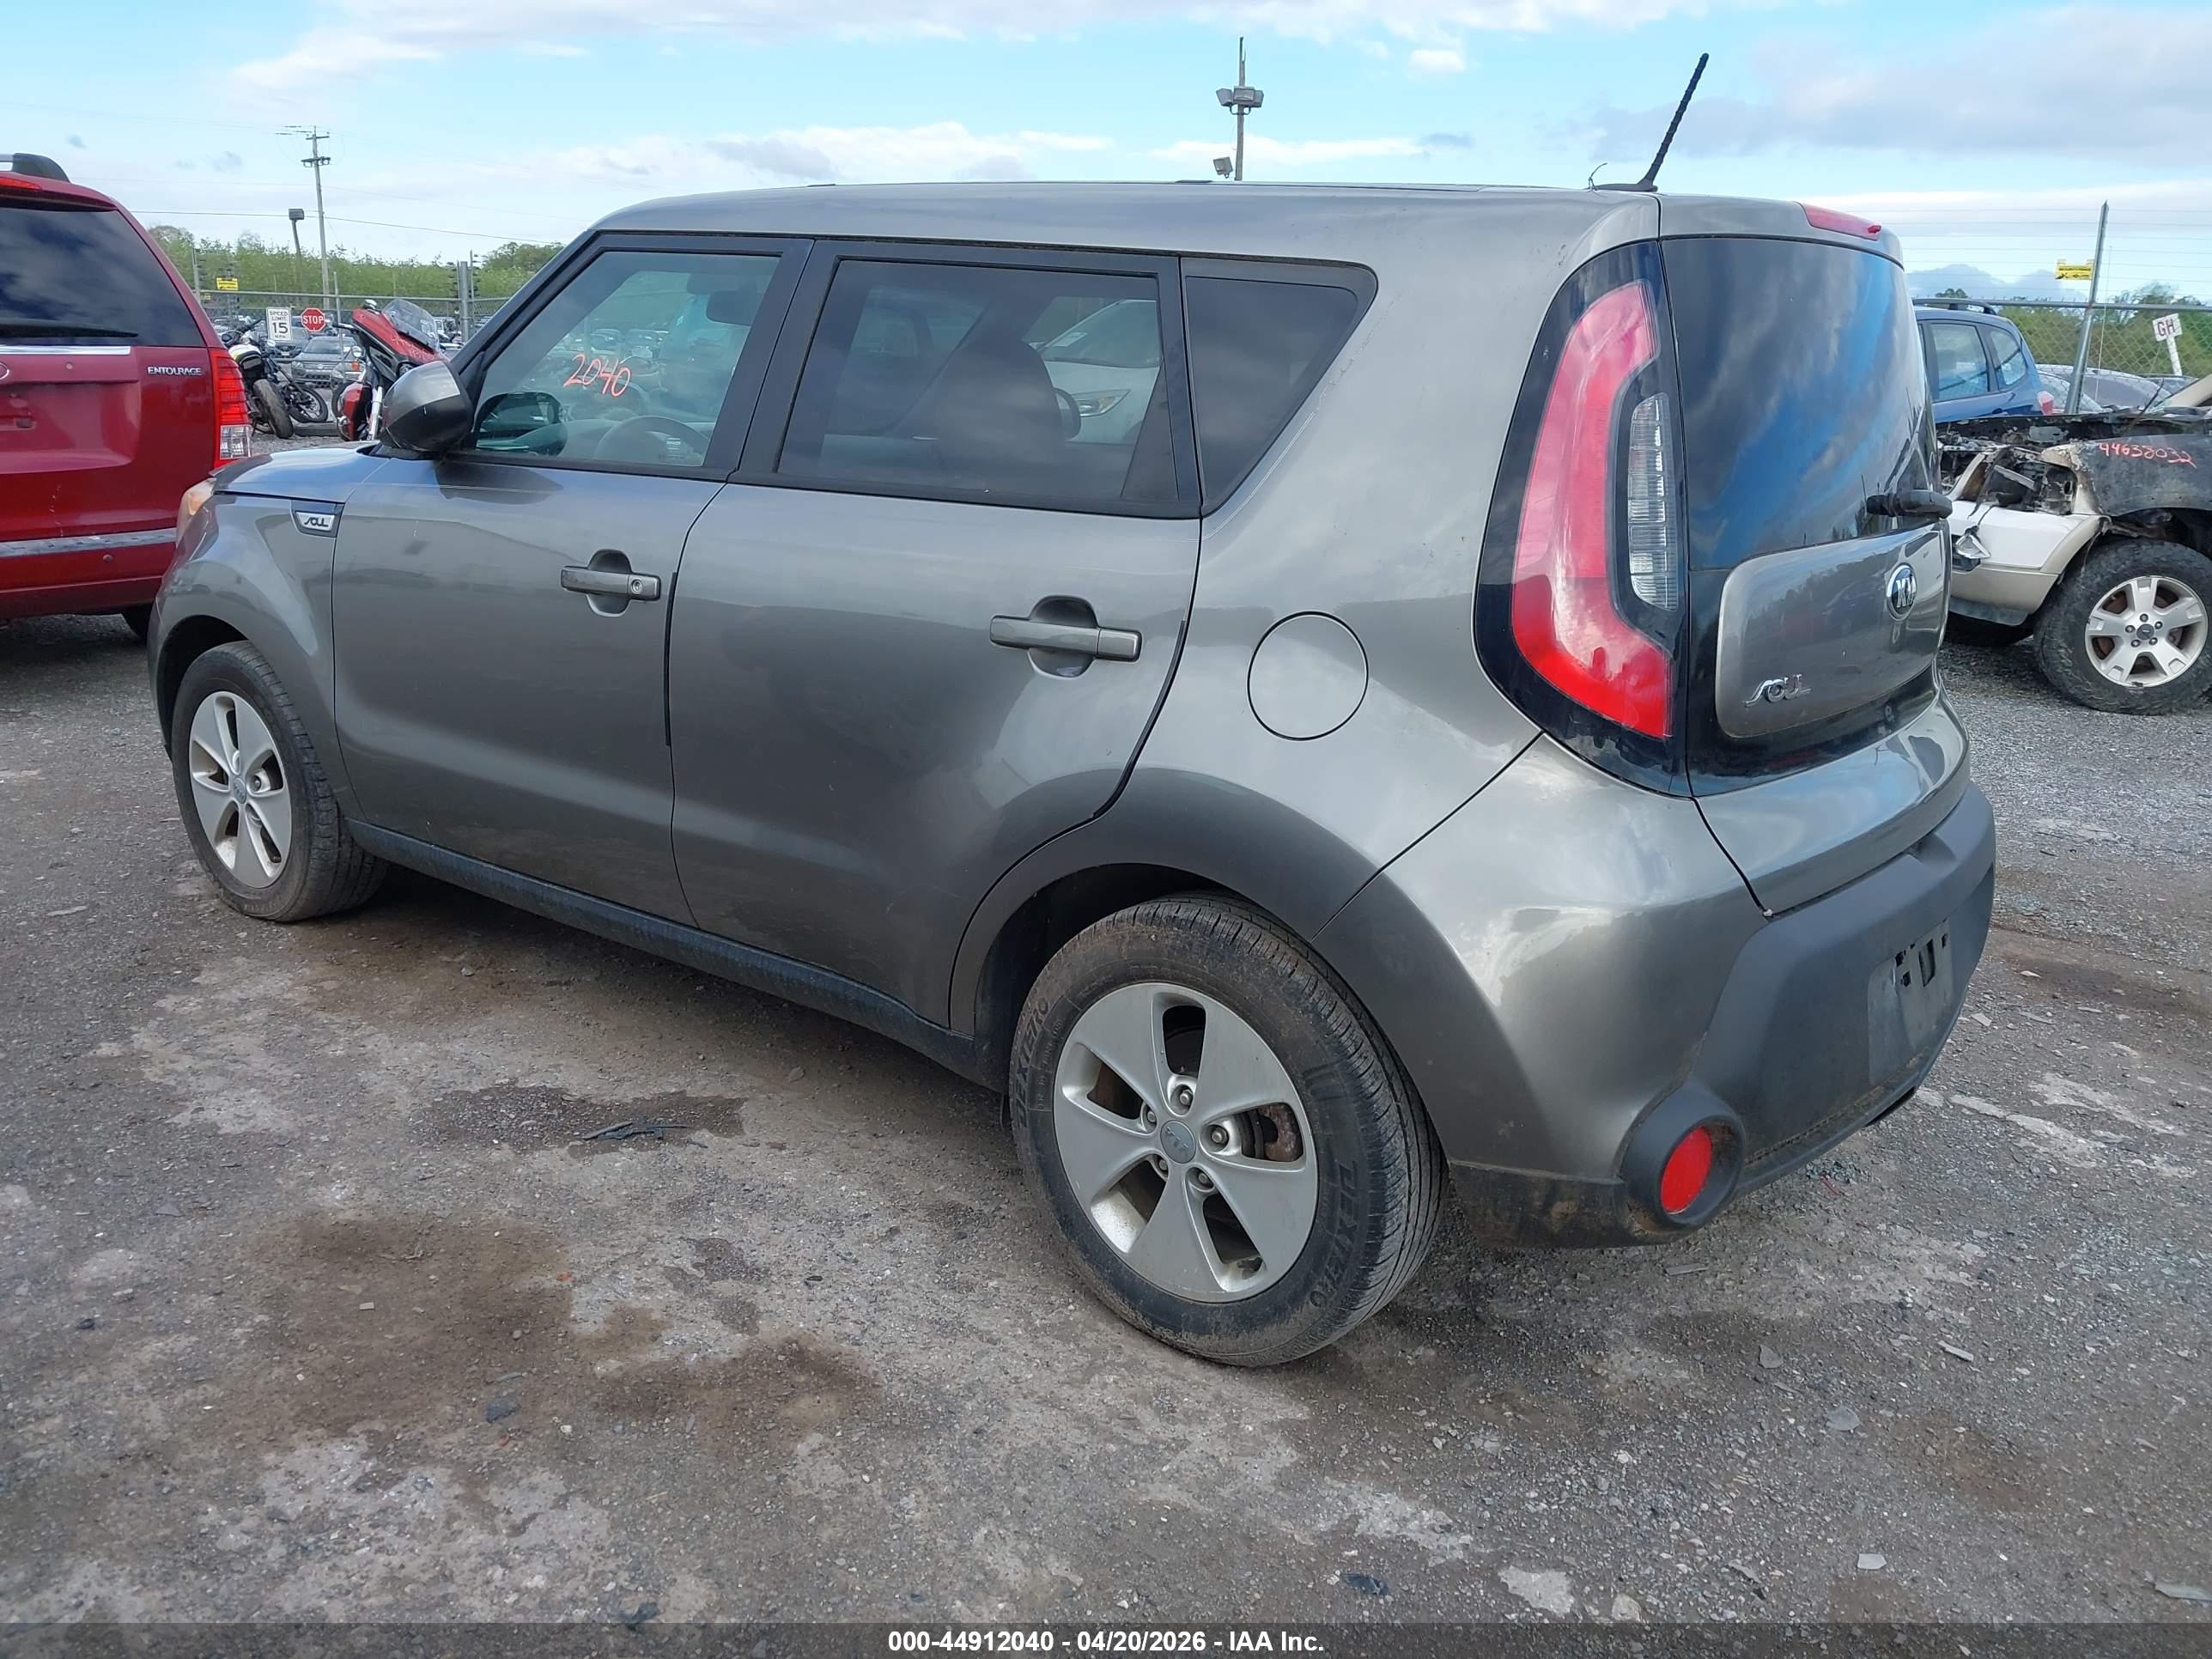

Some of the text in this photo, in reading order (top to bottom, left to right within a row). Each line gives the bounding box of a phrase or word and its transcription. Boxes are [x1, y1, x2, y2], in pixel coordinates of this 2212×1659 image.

[273, 323, 289, 334] 15
[2157, 319, 2176, 337] GH
[147, 366, 203, 376] ENTOURAGE
[563, 354, 631, 397] 2040
